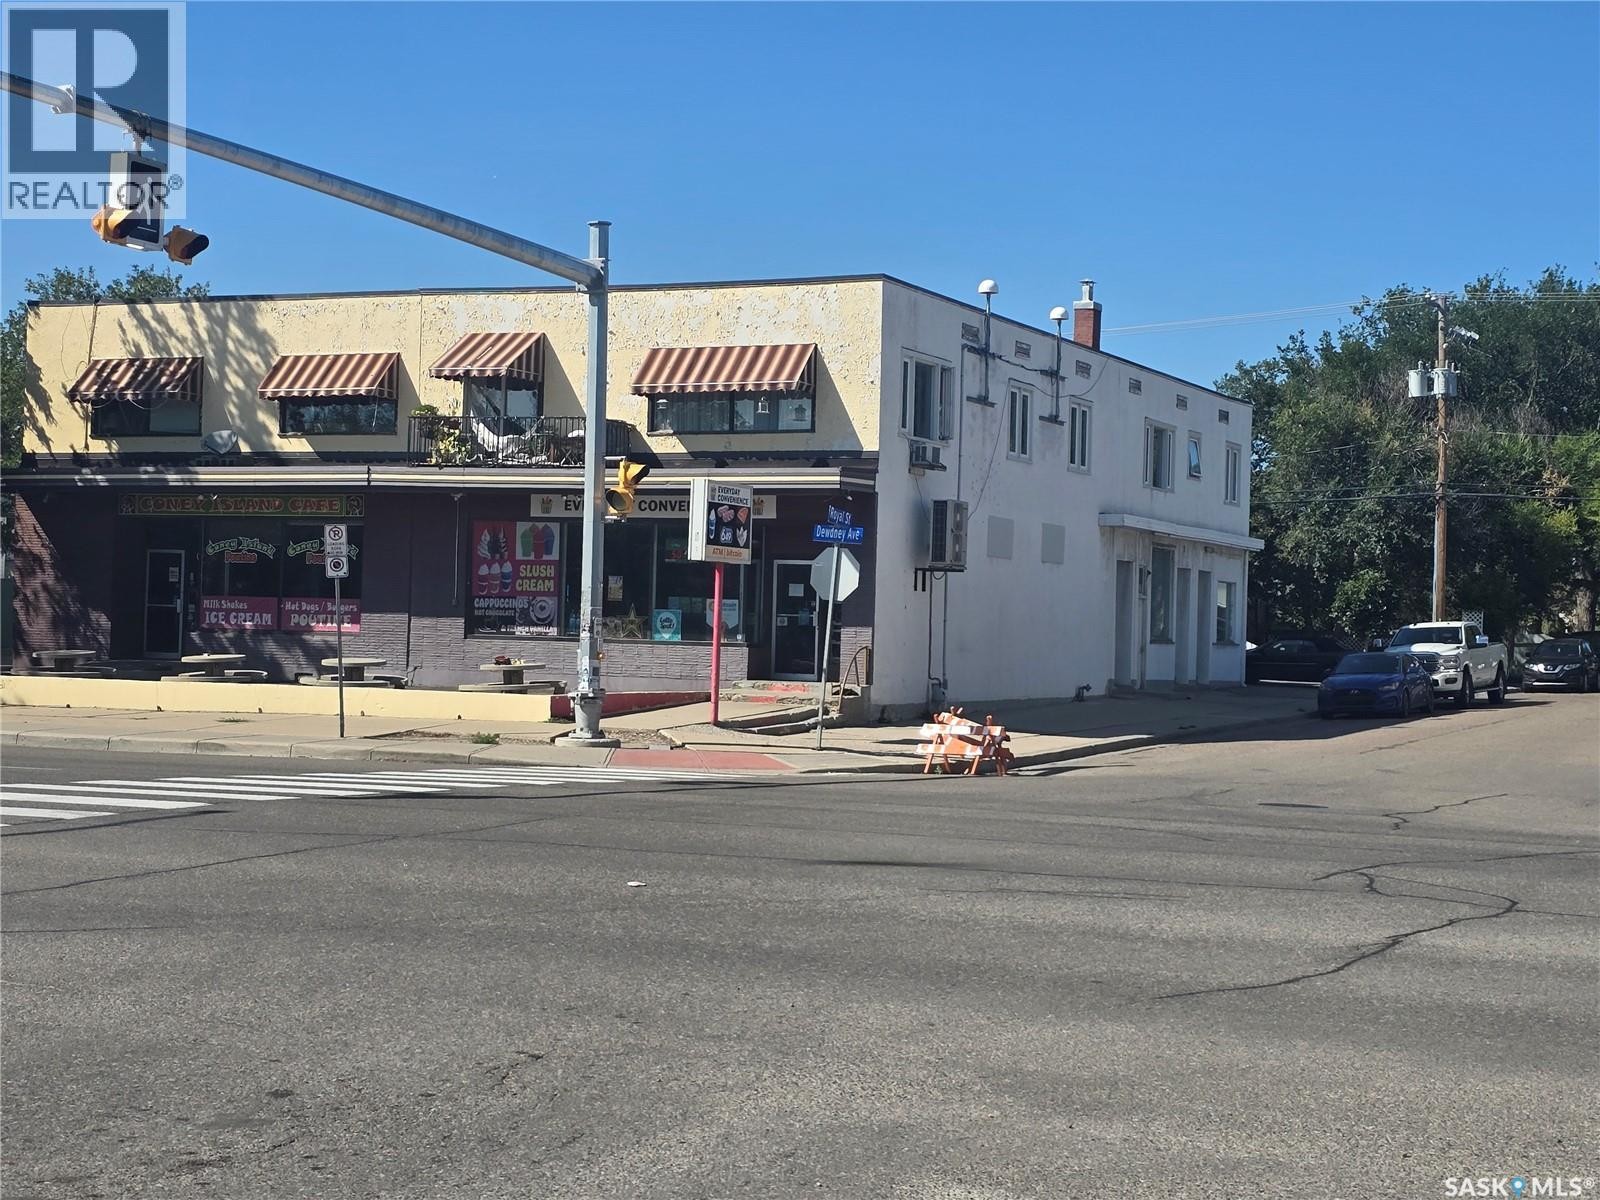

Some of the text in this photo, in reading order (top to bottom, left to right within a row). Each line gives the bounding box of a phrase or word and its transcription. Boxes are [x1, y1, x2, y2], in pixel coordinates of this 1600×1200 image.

[717, 486, 740, 496] EVERYDAY
[139, 496, 341, 513] CONEY ISLAND CAFE
[717, 495, 749, 505] CONVENIENCE
[816, 525, 860, 542] Dewdney Ave
[712, 547, 744, 558] ATM bitcoin
[519, 564, 555, 577] SLUSH
[515, 579, 555, 592] CREAM
[203, 599, 248, 609] Milk Shakes
[285, 601, 300, 610] Hot
[301, 601, 319, 613] Dogs
[327, 602, 358, 613] Bugers
[474, 598, 529, 609] CAPPUCCINOS
[205, 611, 273, 626] ICE CREAM
[485, 609, 515, 617] CHOCOLATE
